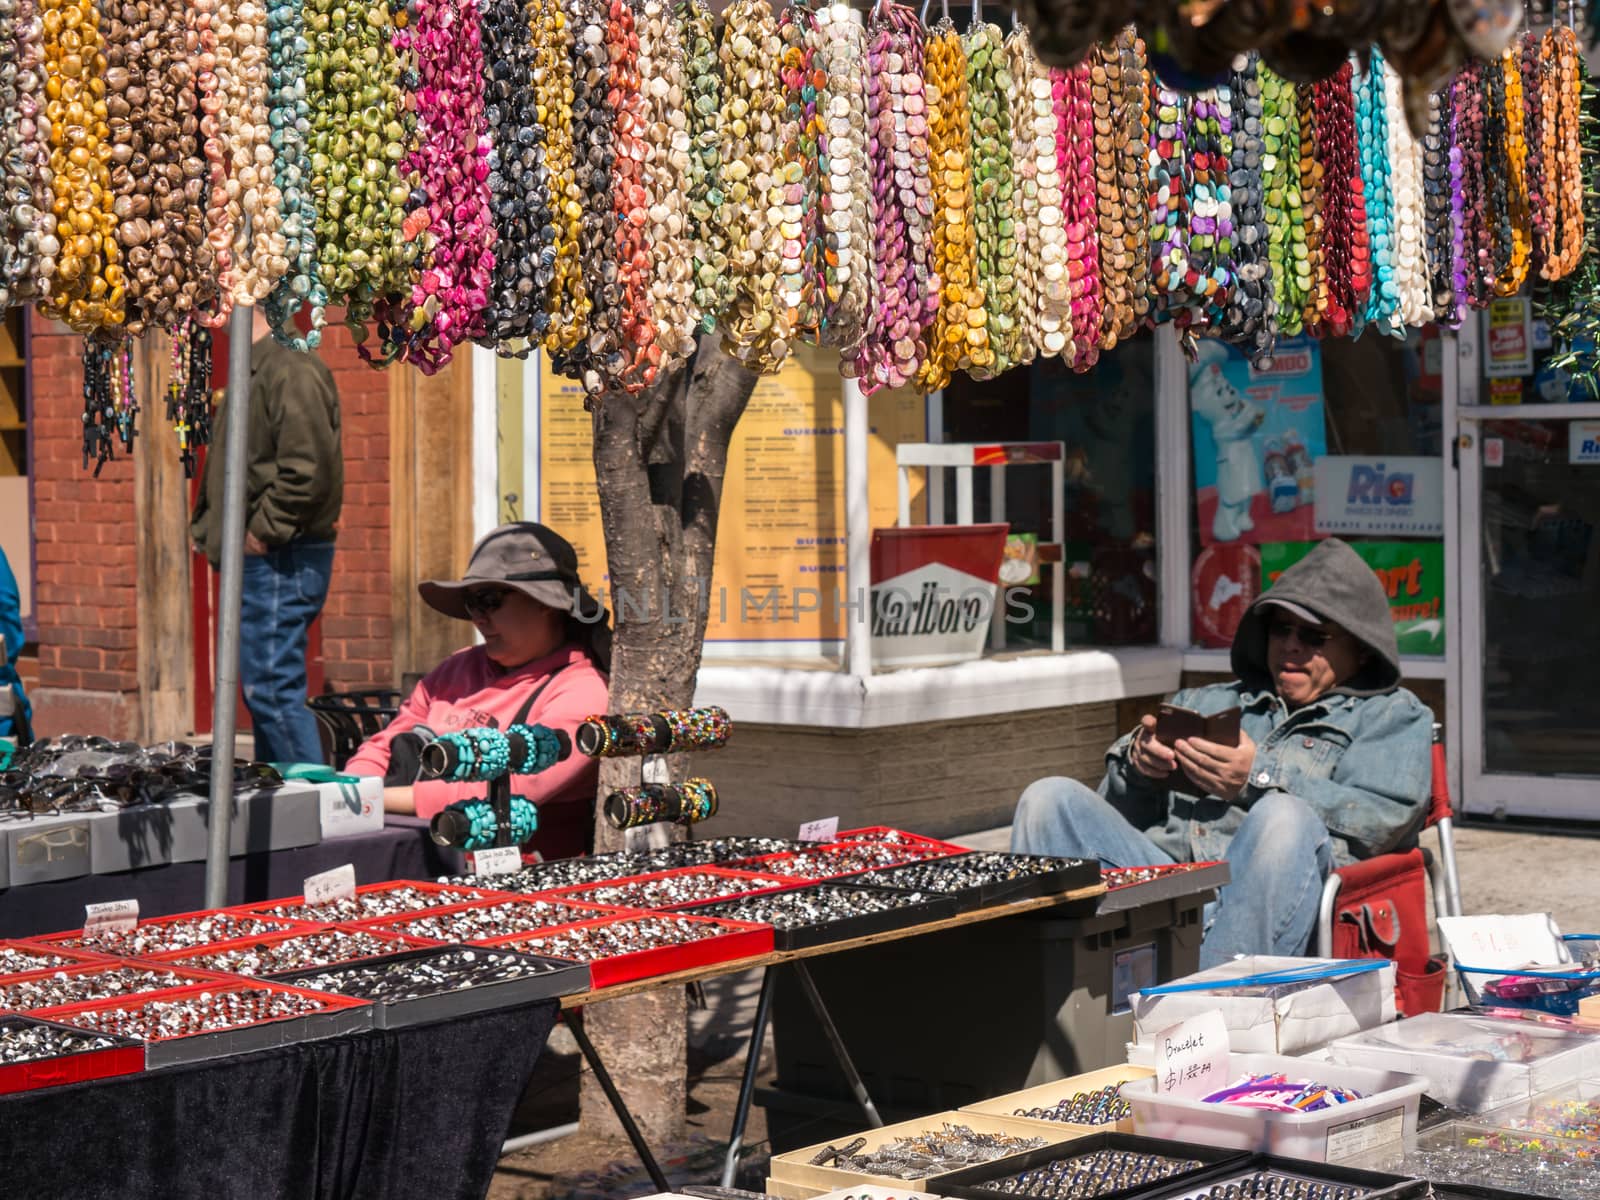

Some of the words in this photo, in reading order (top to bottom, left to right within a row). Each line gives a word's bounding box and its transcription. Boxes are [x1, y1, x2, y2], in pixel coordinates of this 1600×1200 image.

[783, 427, 878, 435] QUESADIS
[1582, 439, 1600, 453] Ri
[1347, 463, 1415, 505] Ria
[796, 537, 847, 545] BURRIT
[799, 565, 846, 573] BURGE
[871, 582, 980, 637] Marlboro
[1165, 1033, 1205, 1060] Bracelet
